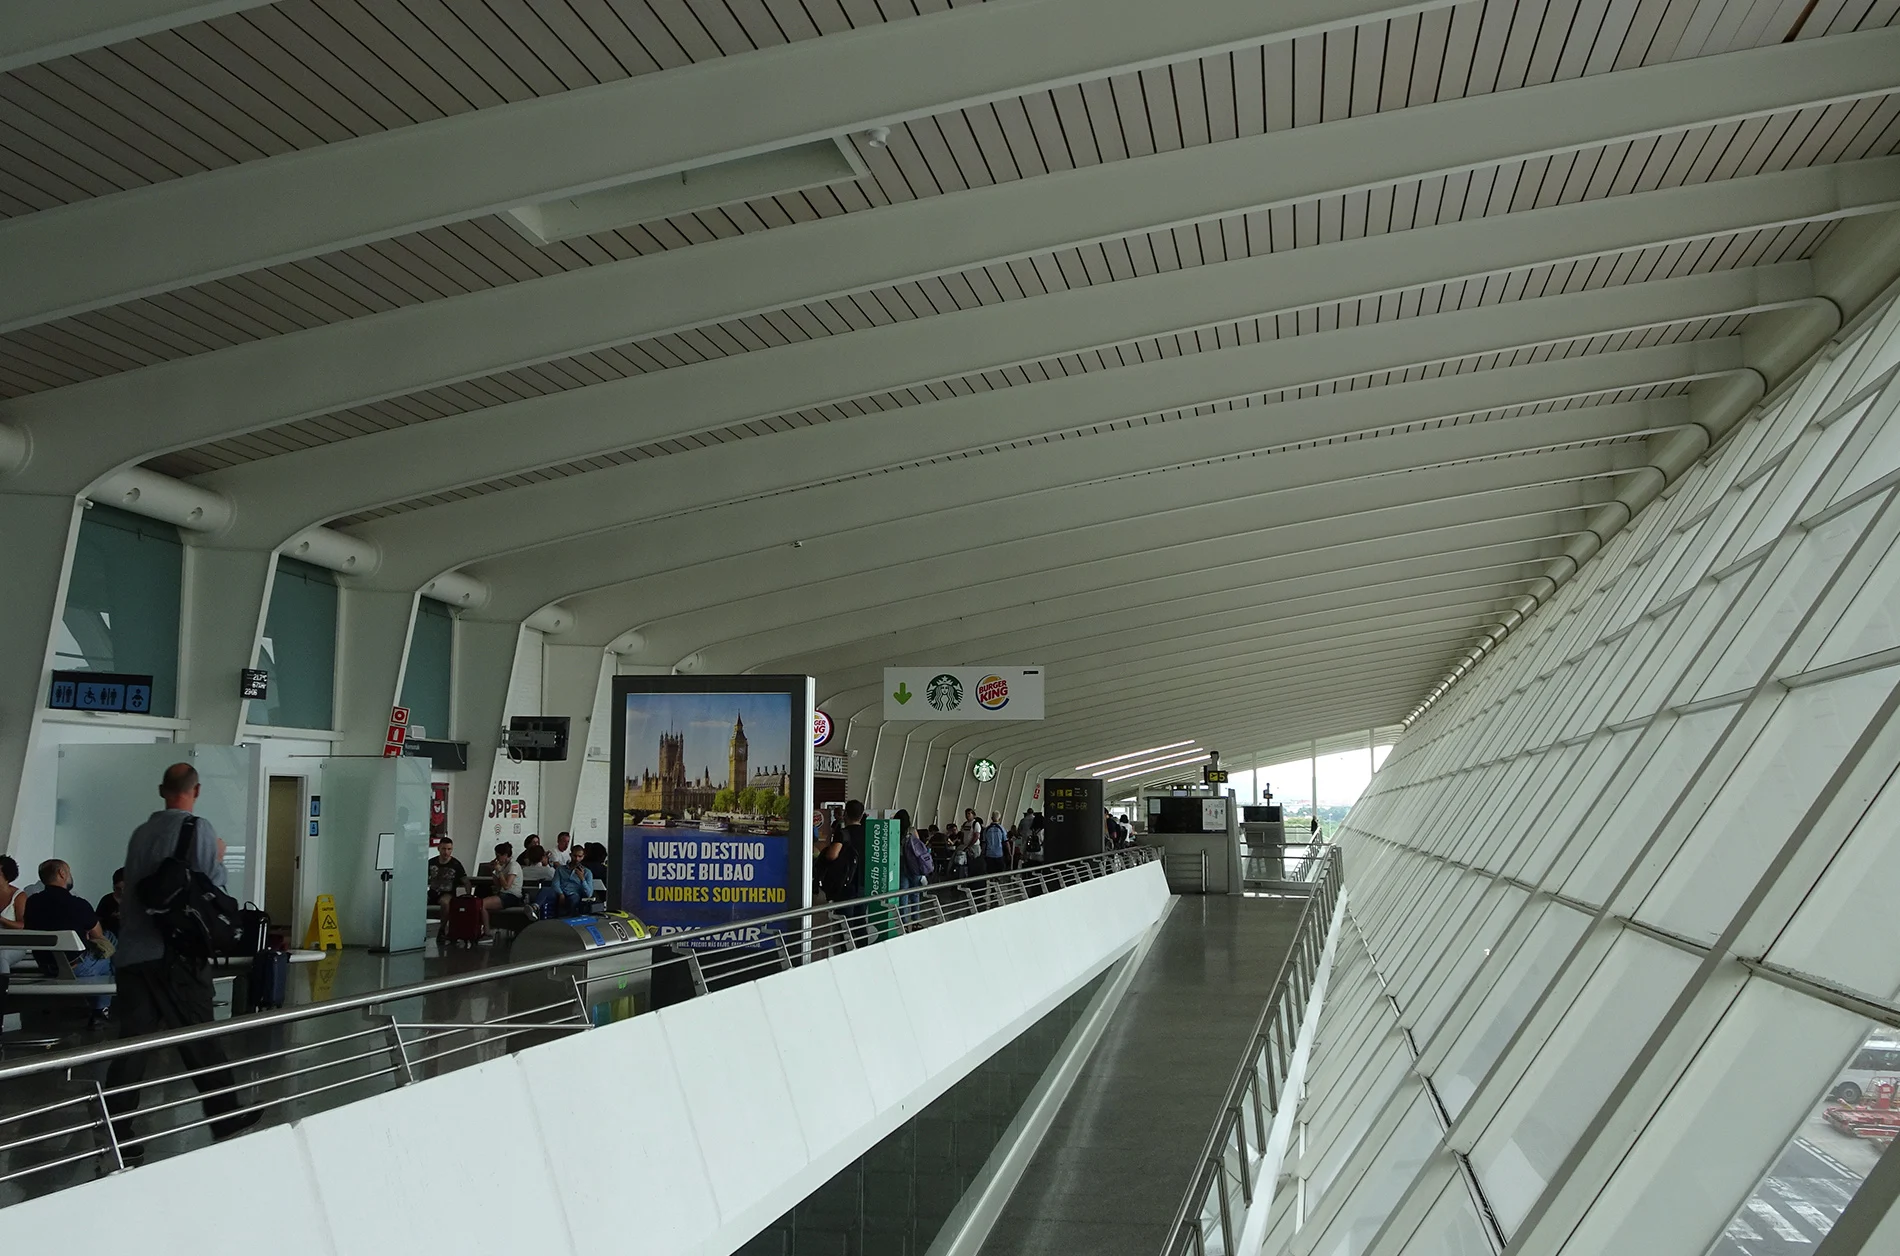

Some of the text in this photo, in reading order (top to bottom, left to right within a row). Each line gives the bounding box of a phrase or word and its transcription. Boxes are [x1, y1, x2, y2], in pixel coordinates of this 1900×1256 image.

[979, 680, 1007, 694] BURGER
[980, 687, 1008, 703] KING
[814, 725, 826, 734] NG
[1219, 772, 1225, 781] 5
[498, 780, 506, 795] OF
[508, 781, 520, 795] THE
[648, 842, 765, 860] NUEVO DESTINO
[648, 863, 754, 881] DESDE BILBAO
[648, 886, 786, 903] LONDRES SOUTHEND
[661, 926, 761, 942] RYNAIR
